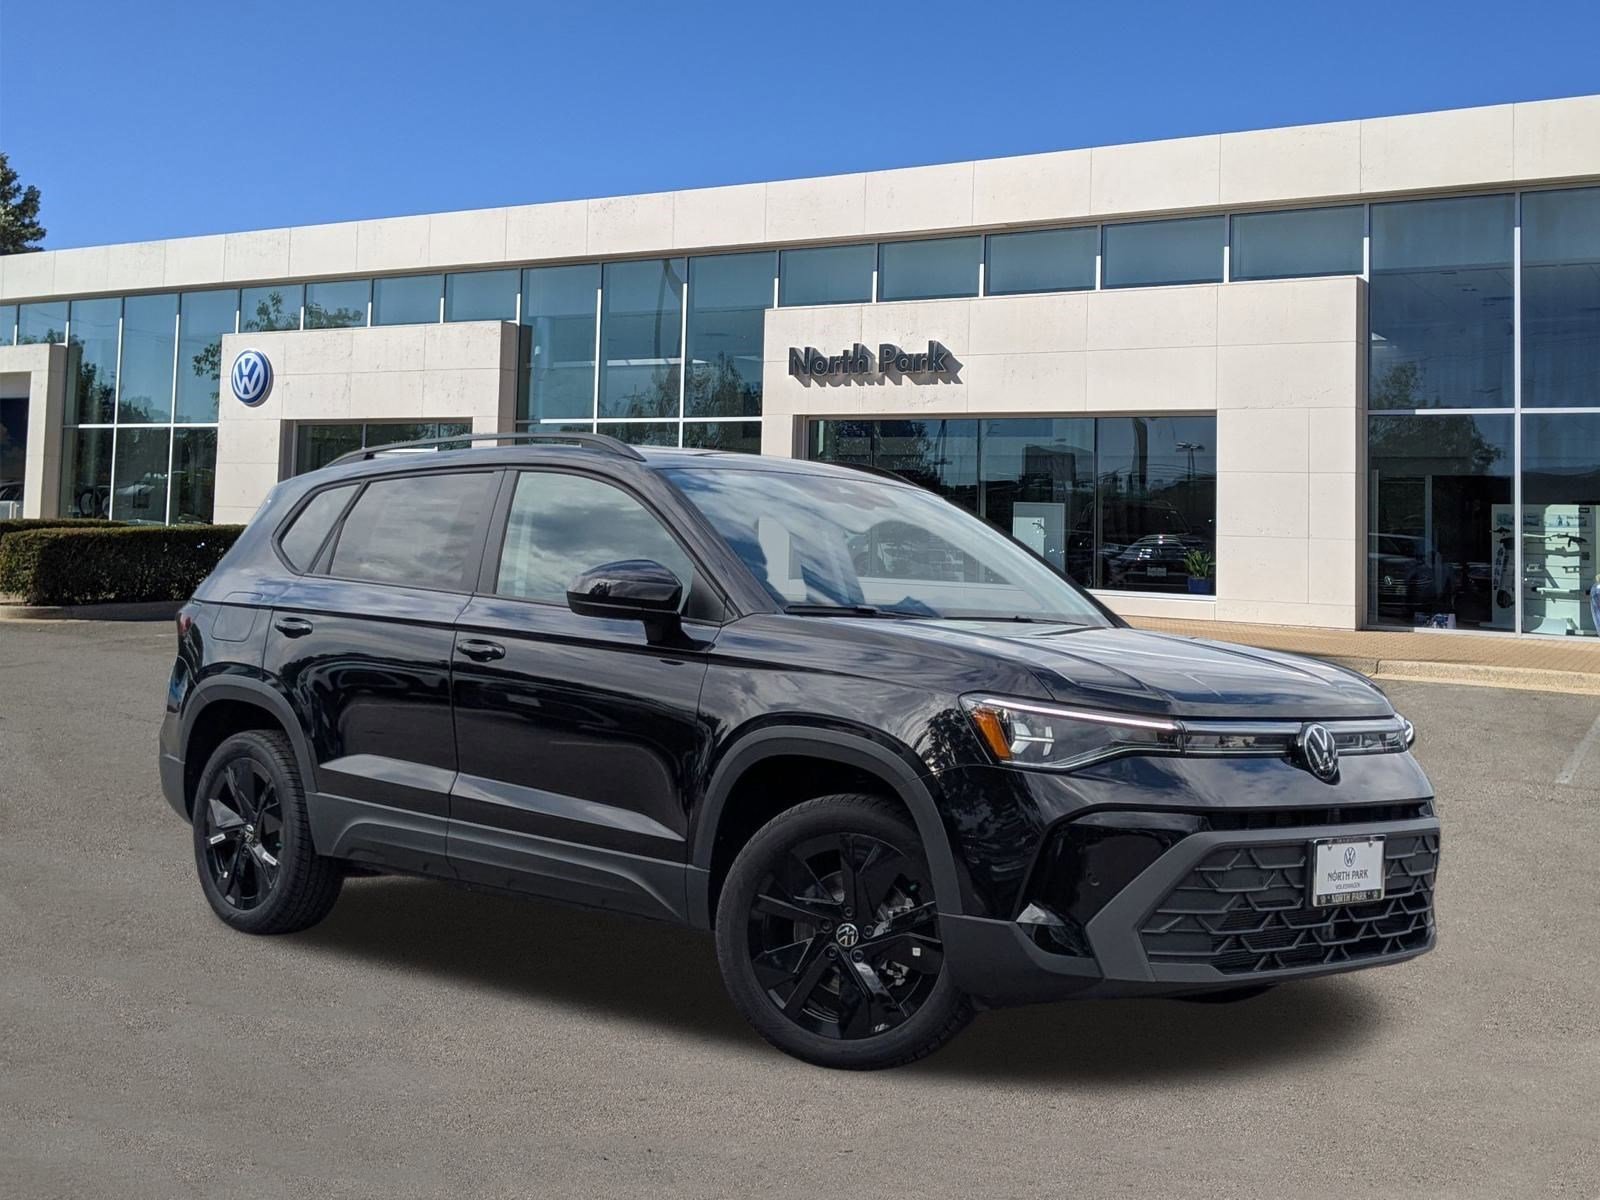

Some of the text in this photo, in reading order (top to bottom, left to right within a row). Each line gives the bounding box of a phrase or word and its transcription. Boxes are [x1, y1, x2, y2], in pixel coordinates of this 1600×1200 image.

[789, 340, 948, 376] North Park
[232, 350, 269, 403] VW
[1305, 724, 1336, 779] VW
[1344, 847, 1355, 867] VW
[1352, 869, 1369, 880] PARK
